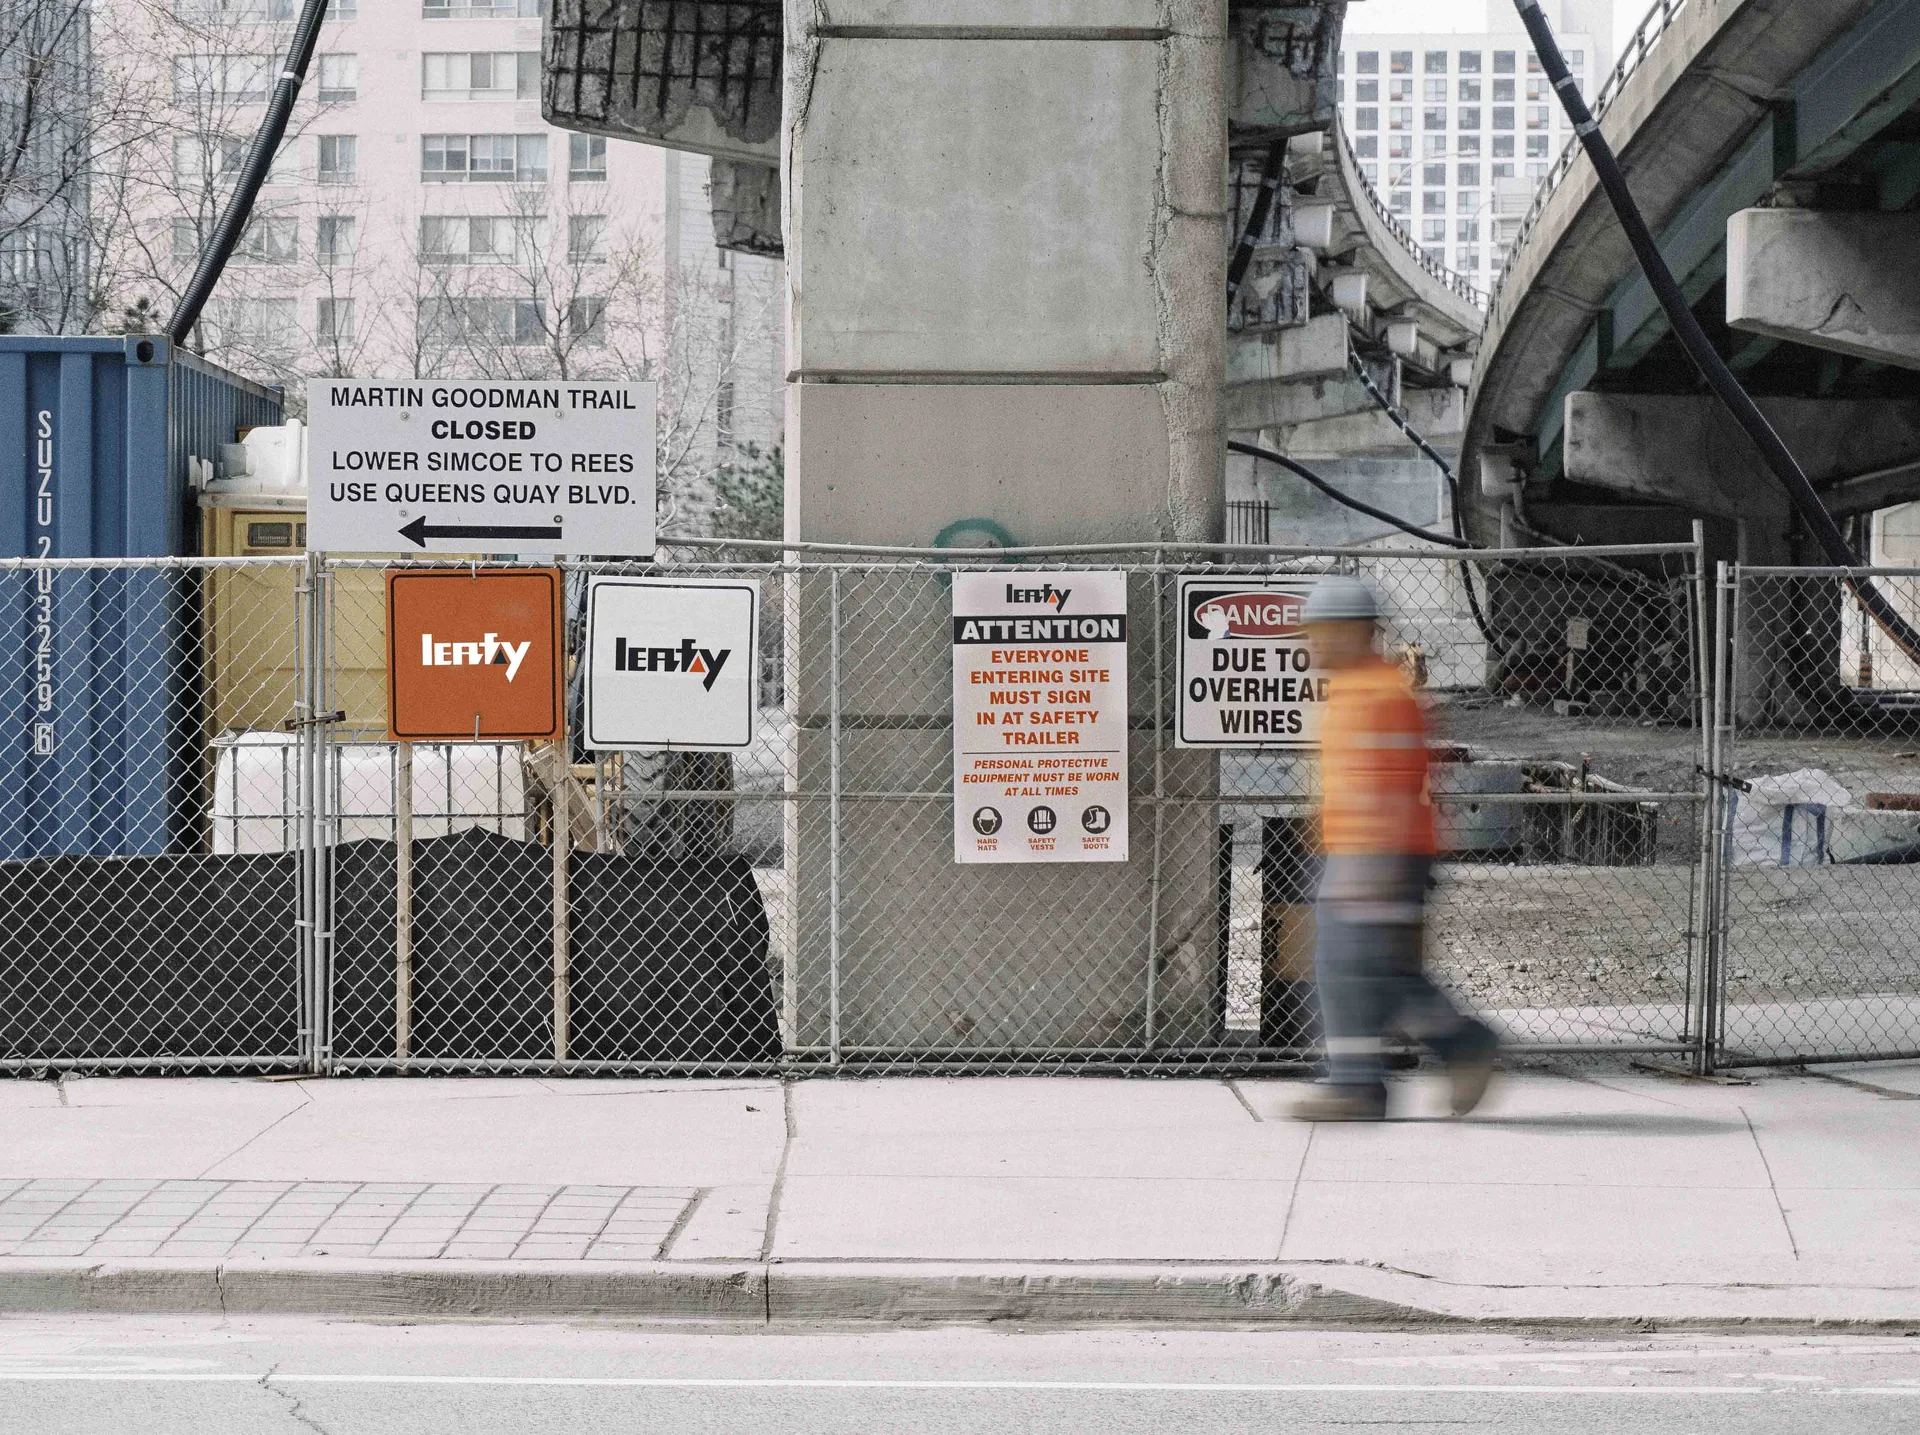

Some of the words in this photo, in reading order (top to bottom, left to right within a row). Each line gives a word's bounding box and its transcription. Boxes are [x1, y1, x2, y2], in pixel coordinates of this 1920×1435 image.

[331, 387, 423, 408] MARTIN
[431, 388, 559, 409] GOODMAN
[568, 389, 636, 410] TRAIL
[431, 420, 536, 440] CLOSED
[37, 410, 51, 526] SUZU
[332, 451, 418, 471] LOWER
[427, 452, 522, 472] SIMCOE
[531, 453, 563, 473] TO
[571, 453, 634, 473] REES
[330, 482, 377, 502] USE
[385, 483, 485, 503] QUEENS
[493, 484, 560, 505] QUAY
[568, 485, 636, 505] BLVD.
[1207, 604, 1306, 626] ANGE
[961, 618, 1120, 640] ATTENTION
[991, 649, 1089, 663] EVERYONE
[1212, 647, 1266, 672] DUE
[1275, 647, 1311, 672] TO
[970, 670, 1064, 684] ENTERING
[1069, 669, 1110, 683] SITE
[989, 691, 1041, 705] MUST
[1047, 690, 1091, 704] SIGN
[1189, 677, 1332, 702] OVERHEAD
[976, 712, 995, 725] IN
[1002, 711, 1024, 725] AT
[1030, 710, 1099, 724] SAFETY
[1219, 709, 1303, 734] WIRES
[37, 725, 51, 752] 6
[1002, 731, 1079, 745] TRAILER
[974, 759, 1034, 769] PERSONAL
[1037, 758, 1108, 768] PROTECTIVE
[963, 773, 1030, 783] EQUIPMENT
[1033, 773, 1065, 783] MUST
[1068, 772, 1082, 782] BE
[1086, 772, 1120, 781] WORN
[1004, 787, 1020, 797] AT
[1021, 787, 1042, 796] ALL
[1045, 786, 1079, 796] TIMES
